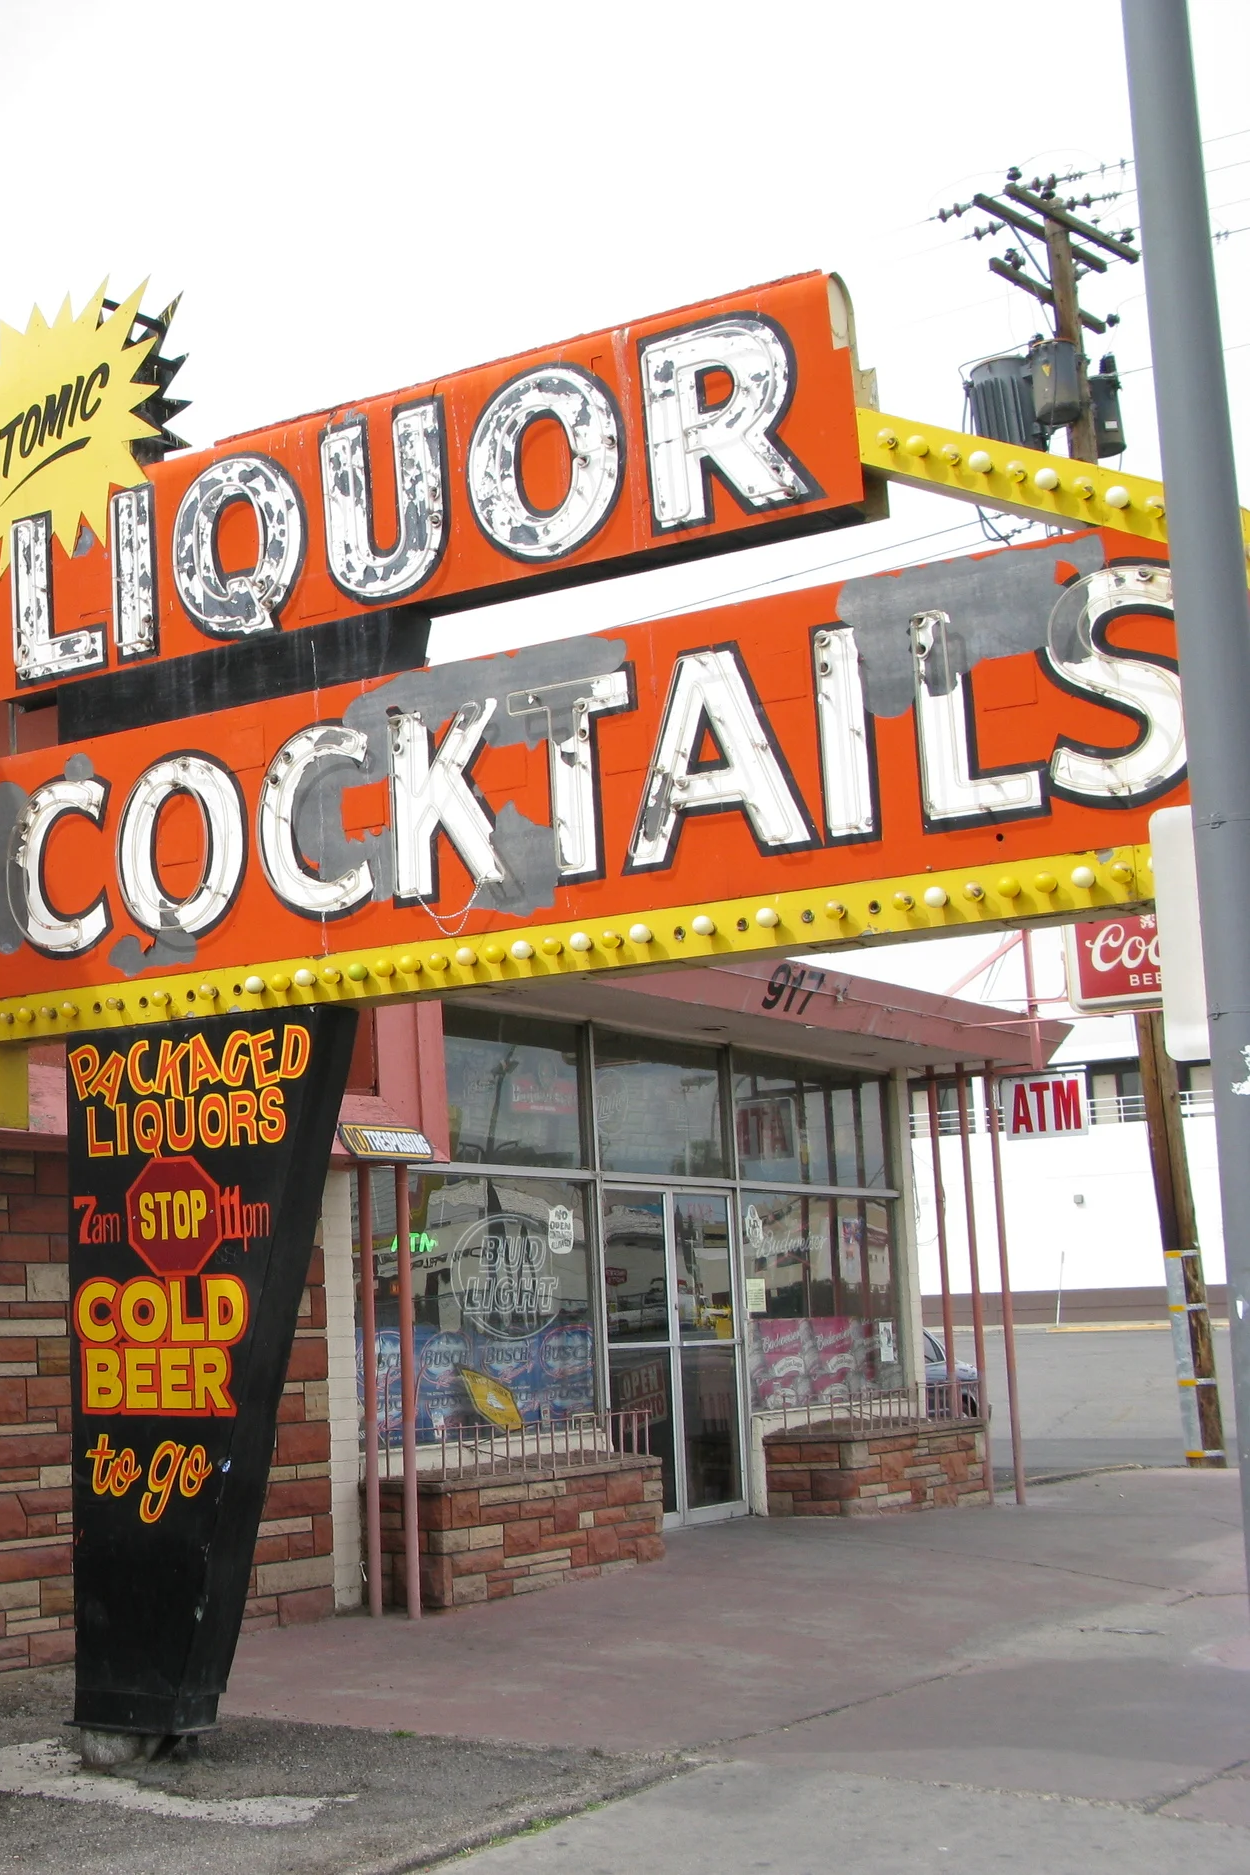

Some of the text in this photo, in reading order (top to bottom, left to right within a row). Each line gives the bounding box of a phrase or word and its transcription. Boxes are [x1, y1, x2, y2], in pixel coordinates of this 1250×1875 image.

[11, 310, 825, 689] LIQUOR
[7, 556, 1188, 959] COCKTAILS
[761, 962, 826, 1016] 917
[68, 1024, 312, 1110] PACKAGED
[86, 1085, 287, 1158] LIQUORS
[1012, 1078, 1082, 1135] ATM
[362, 1130, 432, 1155] TRESPASSING
[73, 1185, 270, 1252] 7am STOP 11pm
[479, 1236, 547, 1273] BUD
[75, 1275, 248, 1345] COLD
[463, 1276, 559, 1315] LIGHT
[81, 1346, 237, 1417] BEER
[424, 1348, 468, 1368] BUSCH
[485, 1345, 530, 1364] BUSCH
[622, 1364, 659, 1400] OPEN
[85, 1433, 212, 1524] to go
